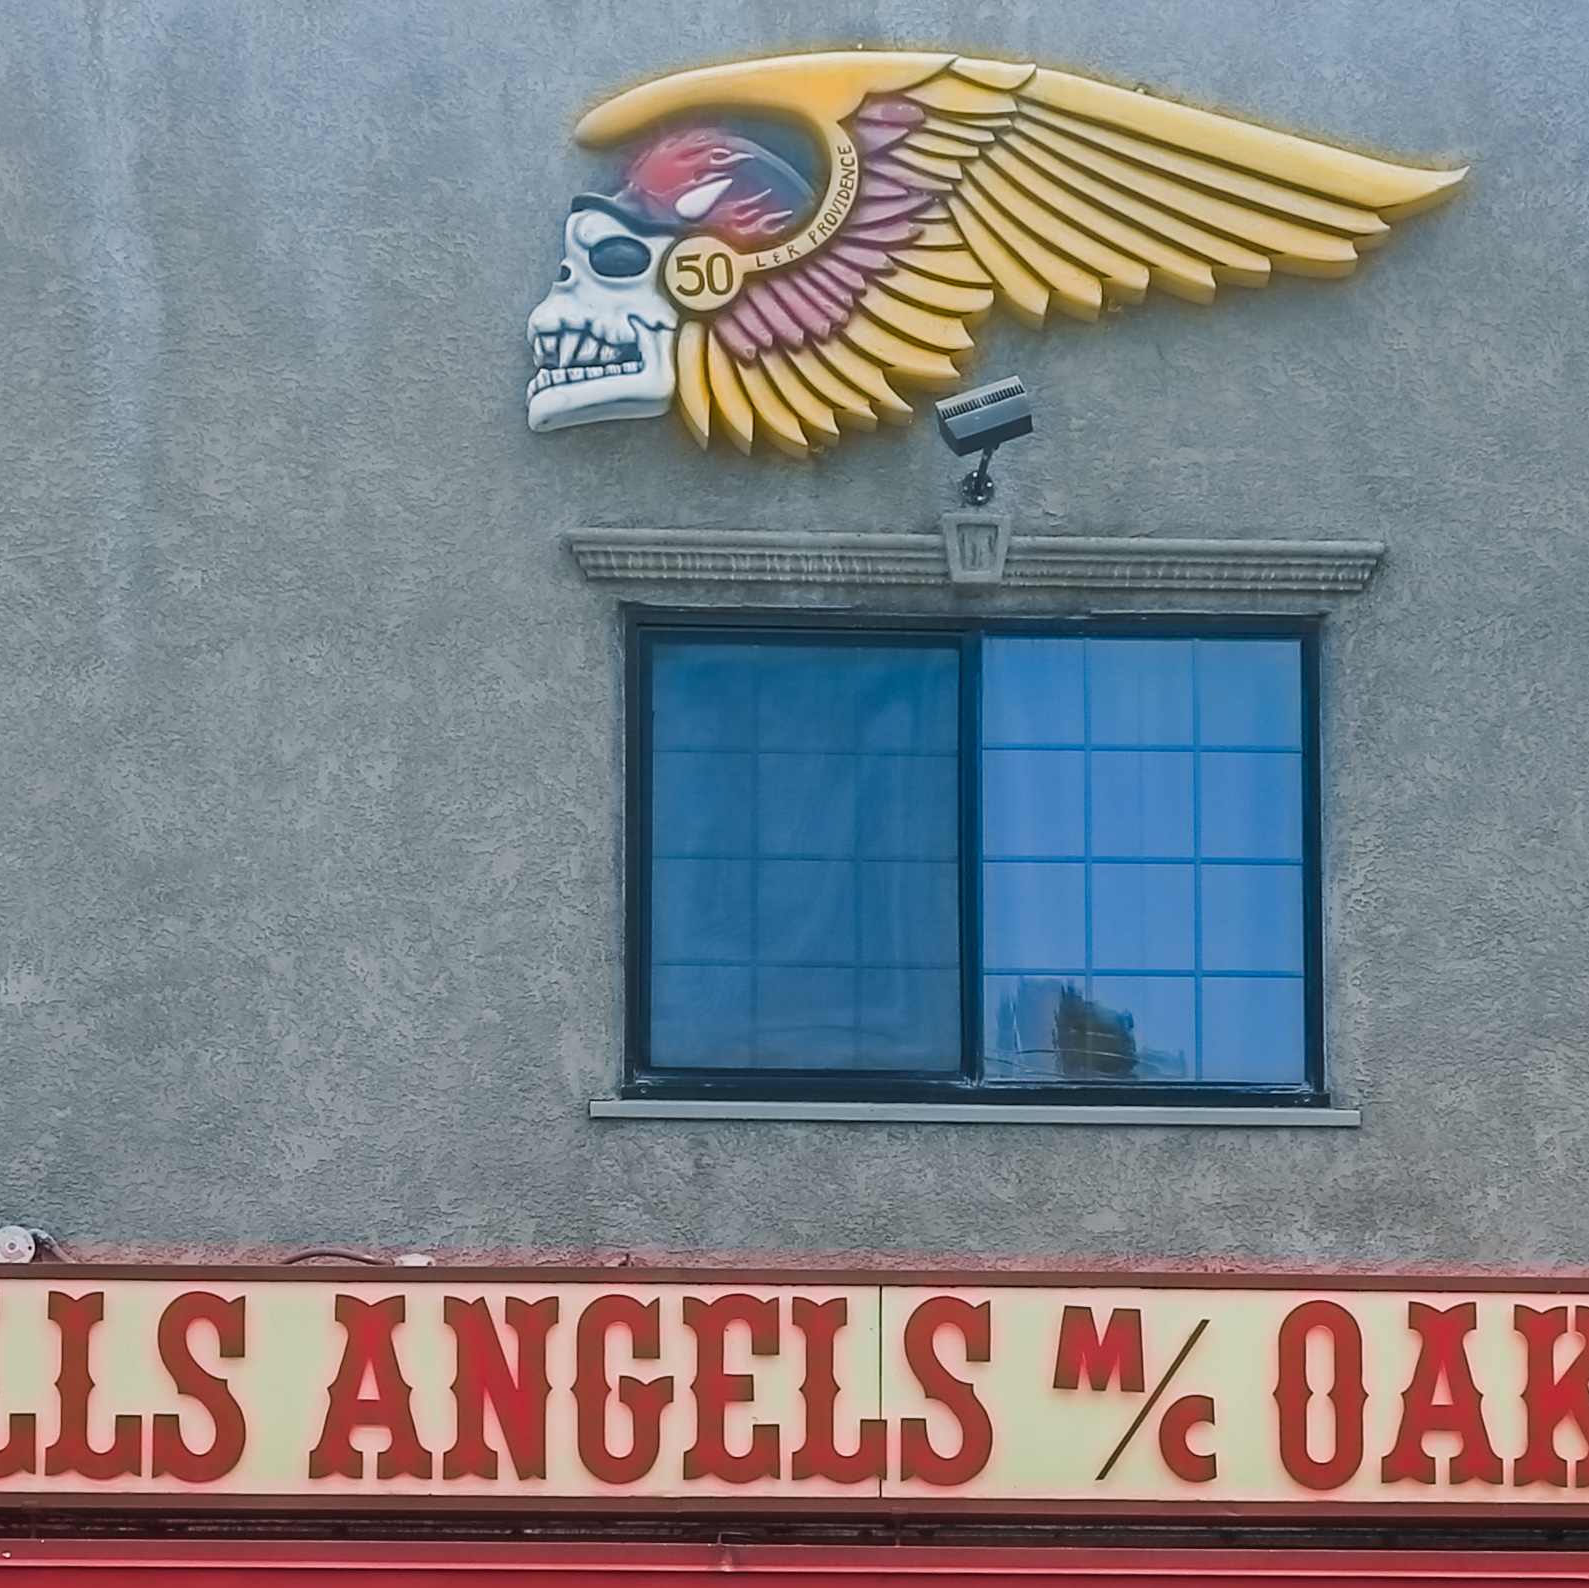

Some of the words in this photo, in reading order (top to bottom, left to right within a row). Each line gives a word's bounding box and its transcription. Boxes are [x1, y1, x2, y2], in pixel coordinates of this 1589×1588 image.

[808, 144, 857, 246] PROVIDENCE
[675, 252, 734, 297] 50
[308, 1291, 994, 1487] ANGELS
